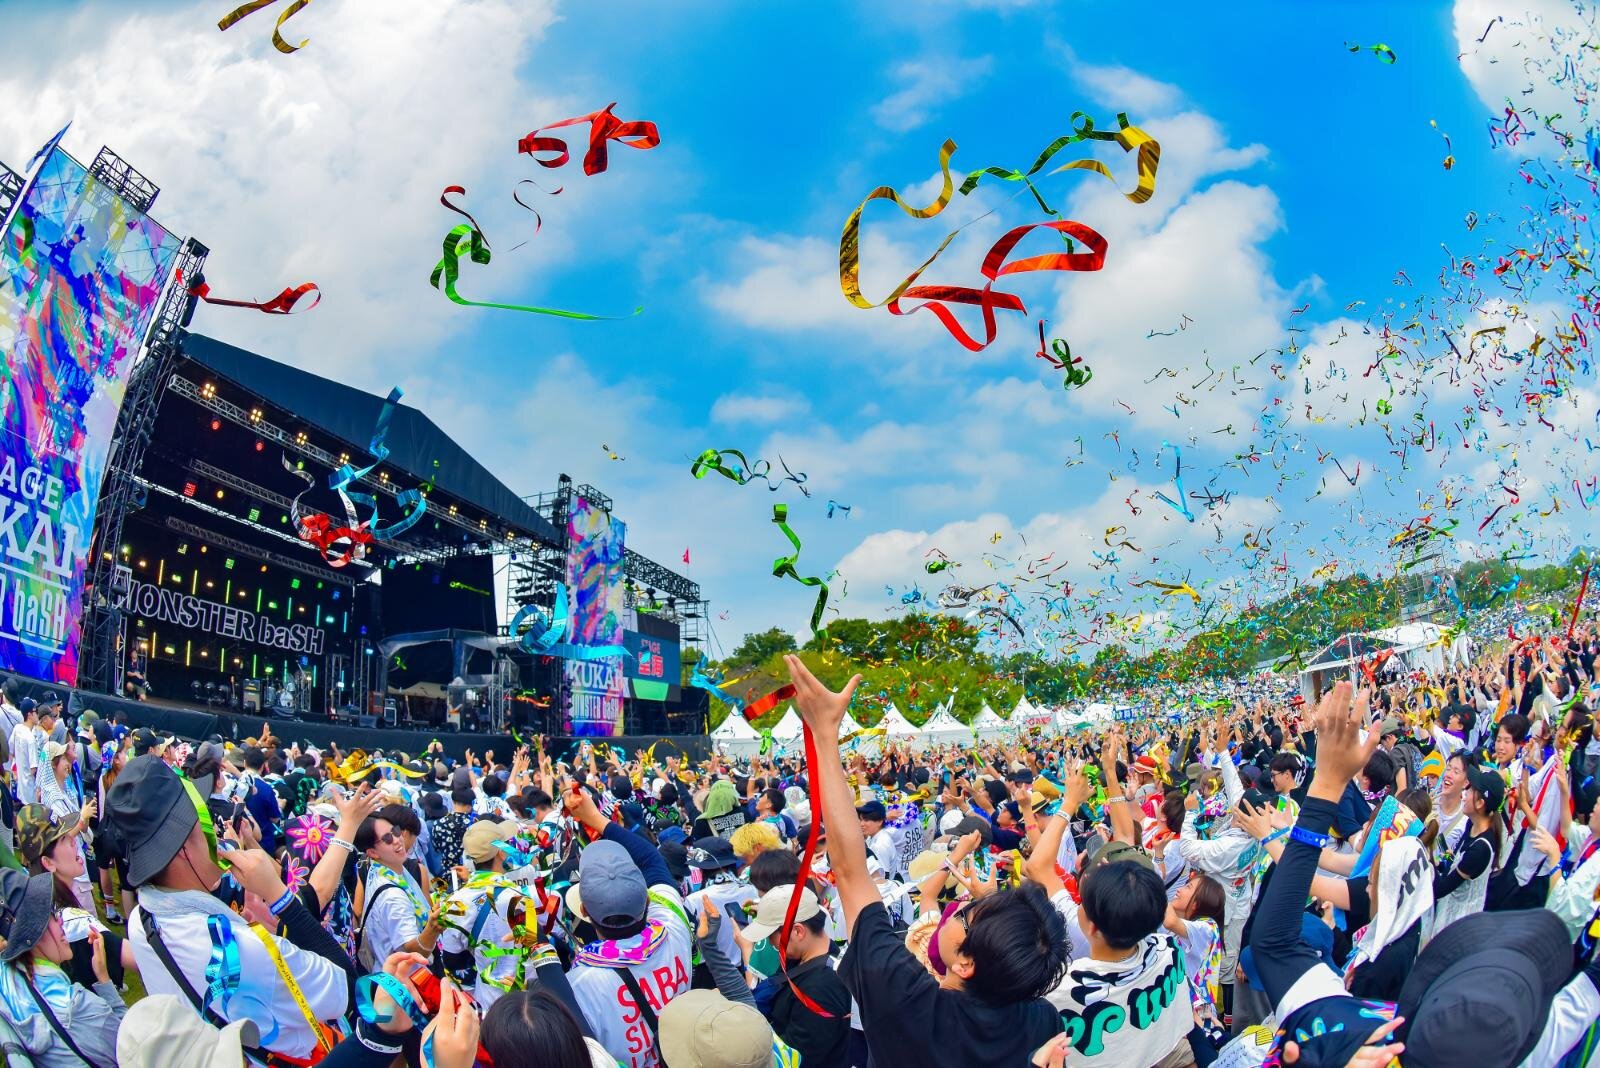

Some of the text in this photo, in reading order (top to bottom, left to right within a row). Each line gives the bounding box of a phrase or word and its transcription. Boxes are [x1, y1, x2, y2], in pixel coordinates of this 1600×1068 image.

[12, 579, 67, 646] baSH
[258, 616, 325, 655] baSH
[617, 955, 689, 1024] SABA
